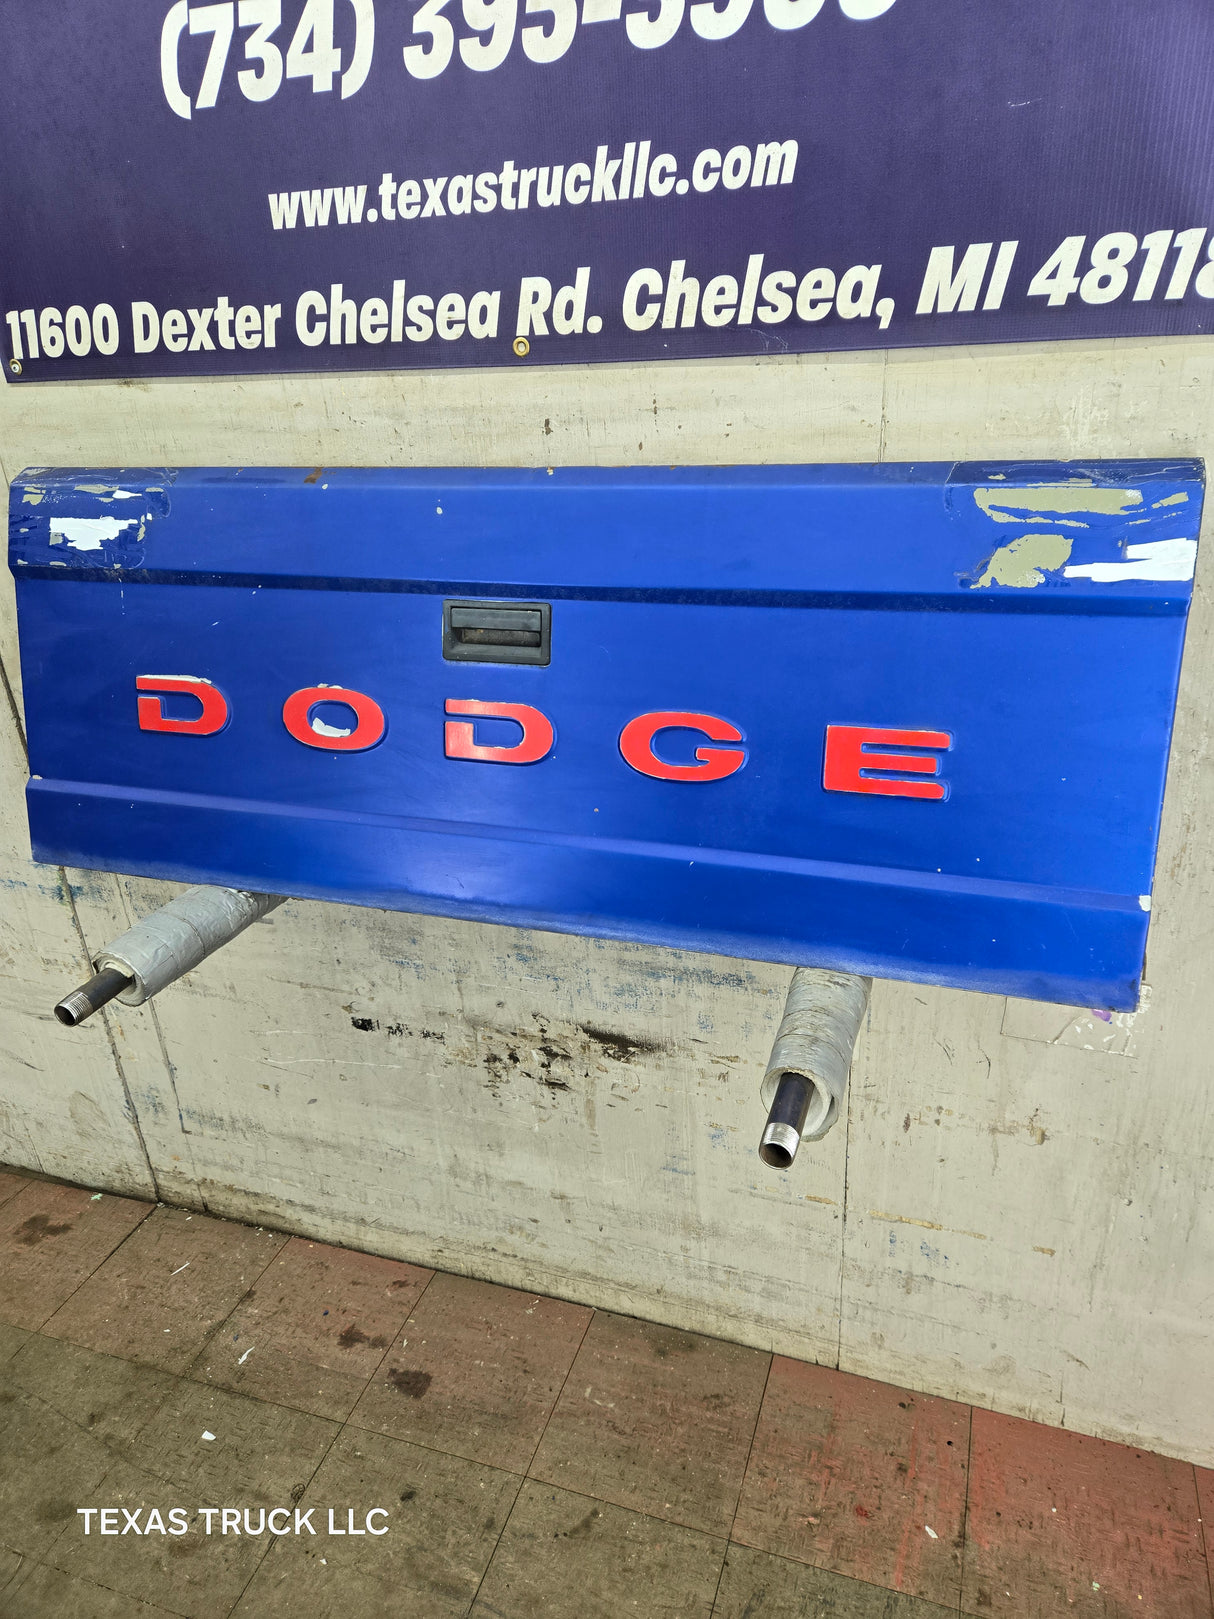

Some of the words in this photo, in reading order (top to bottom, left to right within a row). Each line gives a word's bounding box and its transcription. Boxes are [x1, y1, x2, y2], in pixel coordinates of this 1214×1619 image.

[161, 0, 375, 120] (734)
[268, 140, 798, 229] www.texastruckllc.com
[6, 302, 120, 361] 11600
[132, 296, 281, 354] Dexter
[296, 279, 501, 345] Chelsea
[516, 266, 603, 336] Rd.
[623, 254, 896, 332] Chelsea,
[916, 240, 1019, 315] MI
[136, 674, 954, 802] DODGE
